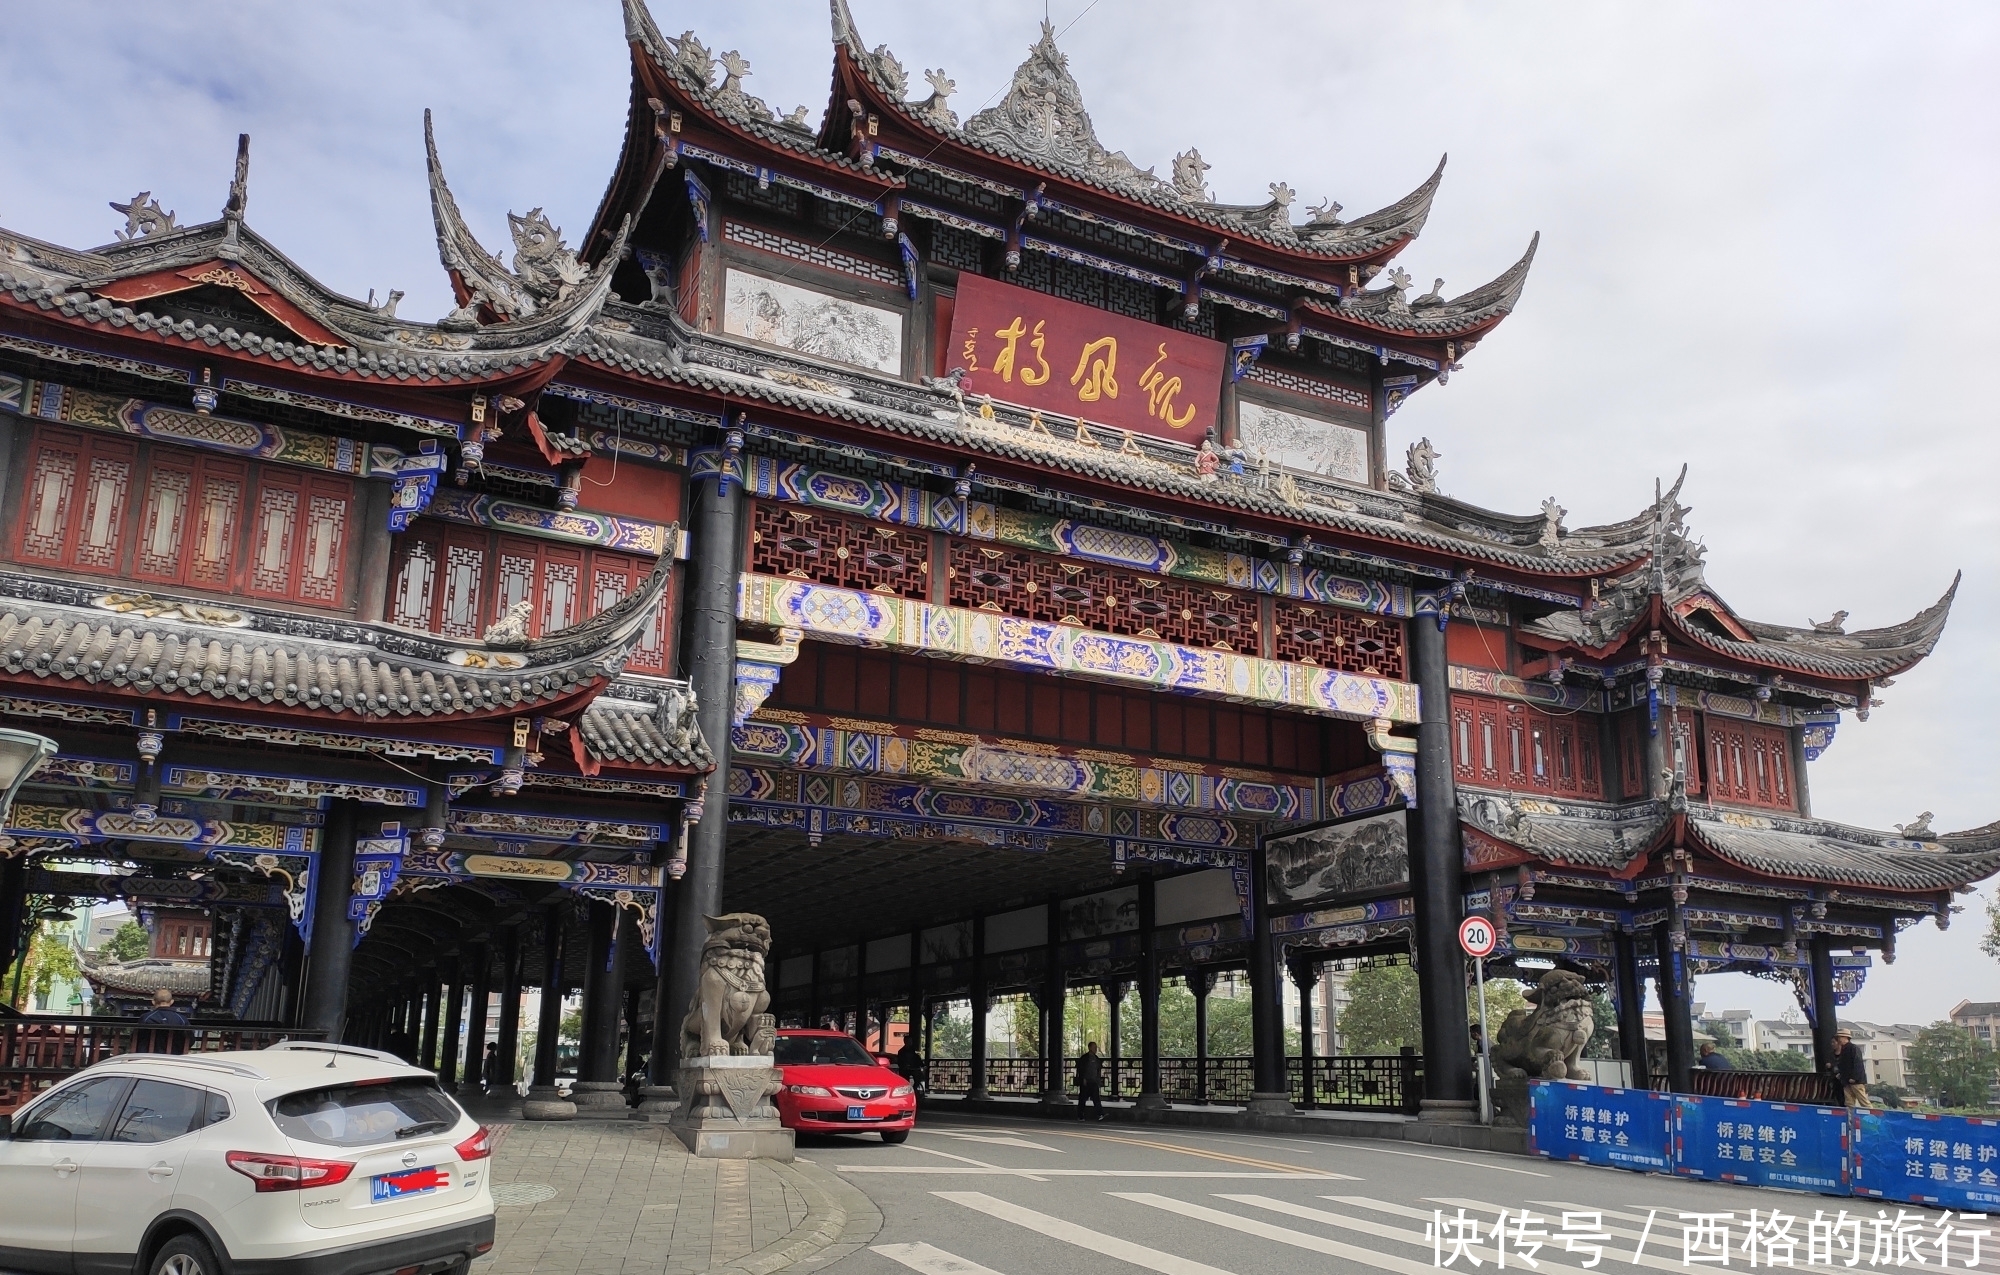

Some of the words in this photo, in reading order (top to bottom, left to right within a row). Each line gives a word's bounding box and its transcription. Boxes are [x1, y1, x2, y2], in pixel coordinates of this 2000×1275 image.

[1564, 1104, 1630, 1127] 桥梁维护
[1564, 1124, 1629, 1147] 注意安全
[1716, 1121, 1797, 1144] 桥梁维护
[1717, 1142, 1797, 1166] 注意安全
[1904, 1136, 1998, 1163] 桥梁维护
[1904, 1159, 1998, 1187] 注意安全
